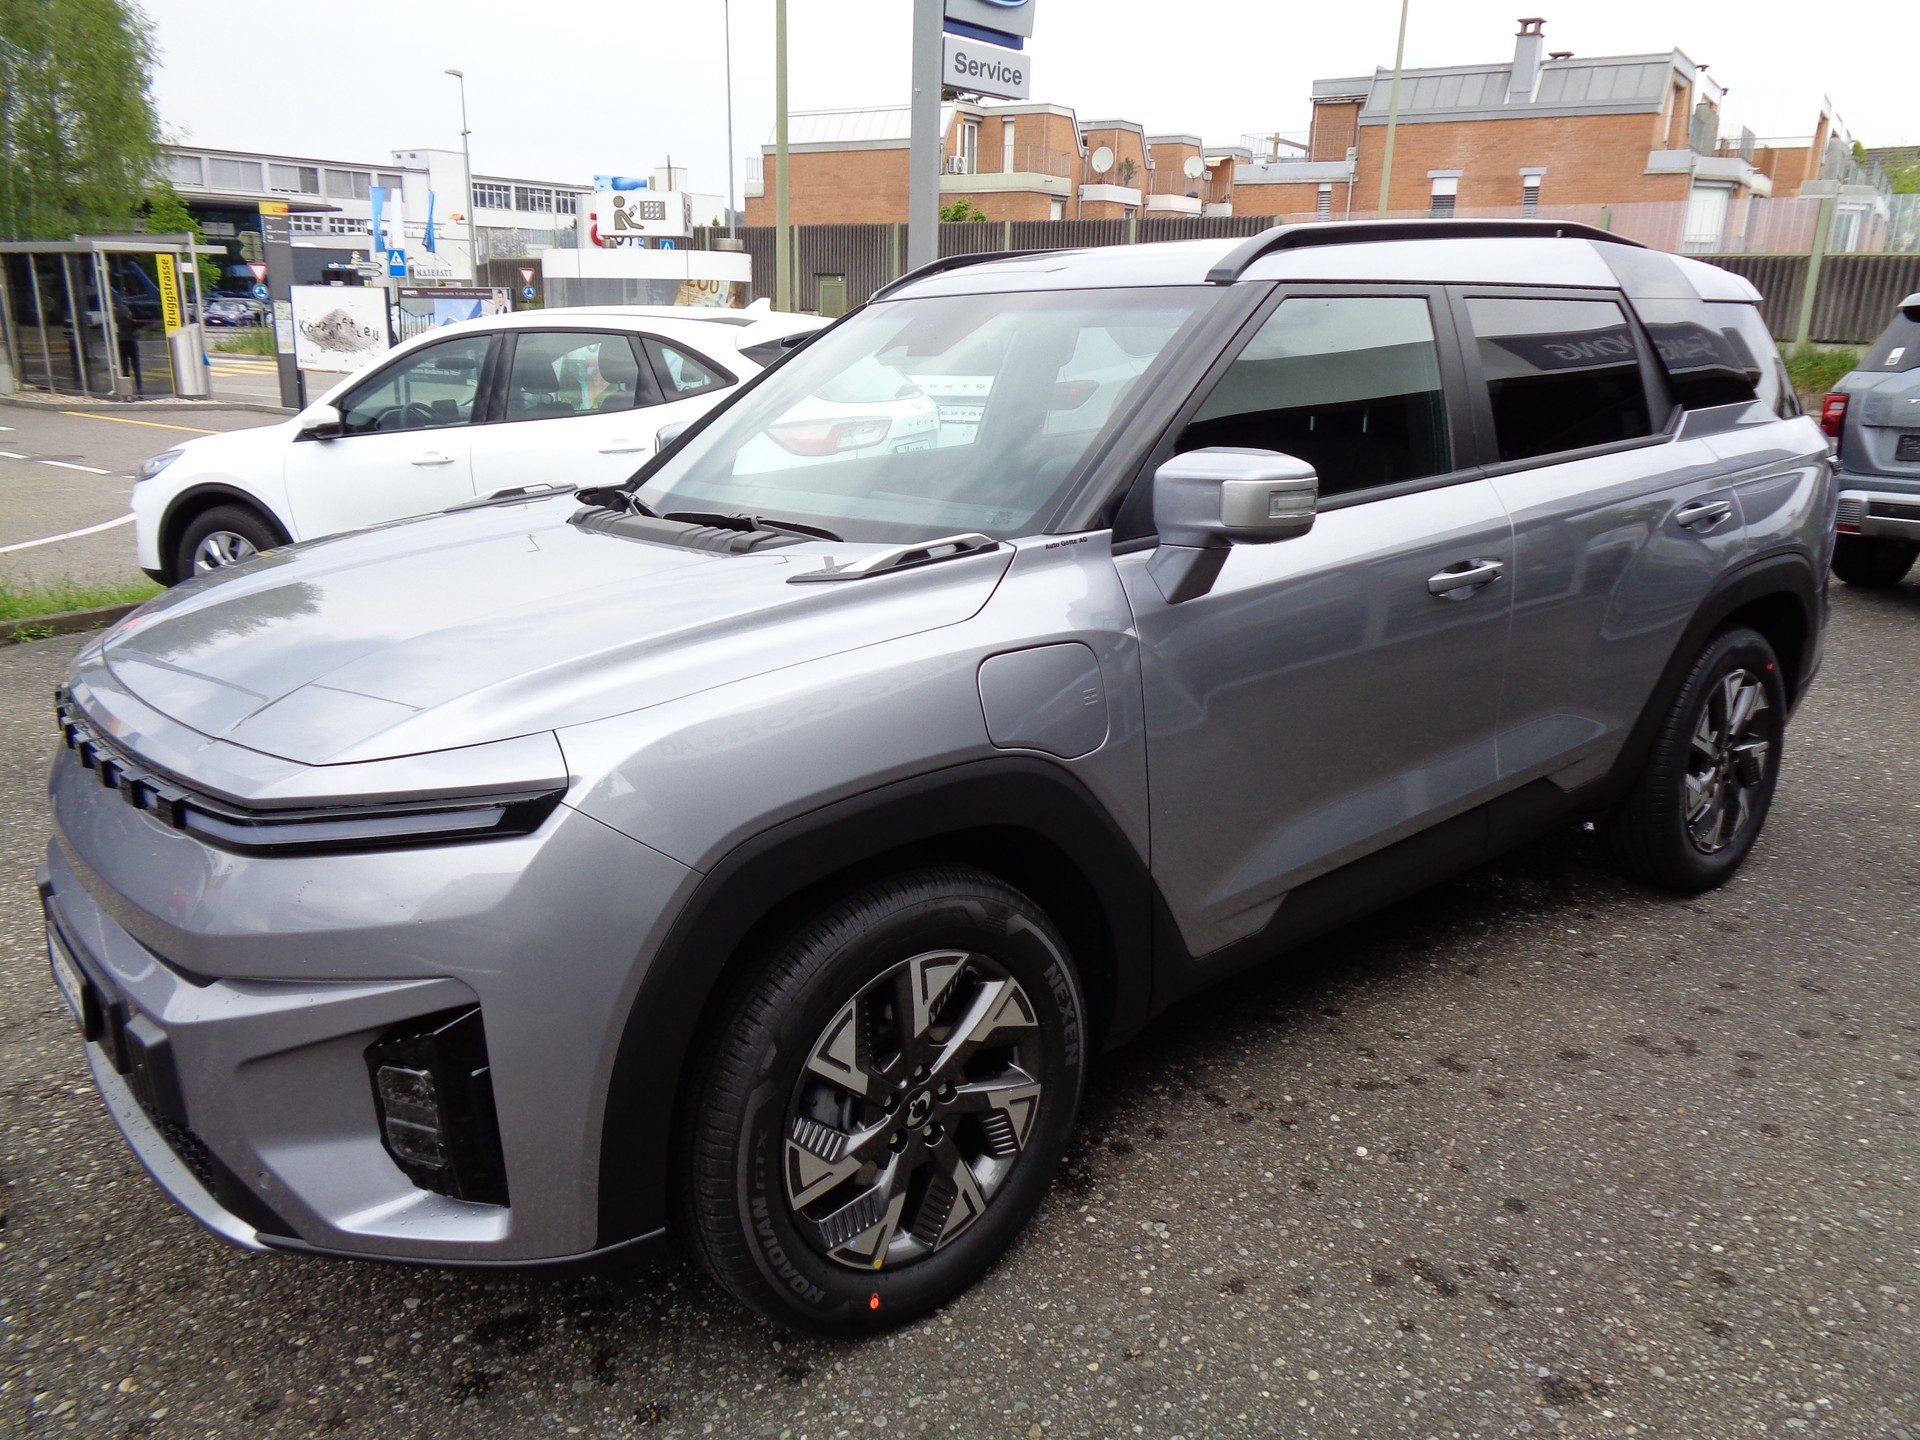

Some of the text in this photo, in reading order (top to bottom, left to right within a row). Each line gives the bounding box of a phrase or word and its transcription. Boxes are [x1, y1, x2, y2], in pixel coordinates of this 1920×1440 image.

[954, 52, 1022, 86] Service
[161, 258, 177, 327] Bruggstrasse
[416, 268, 453, 277] MASERATI
[1043, 962, 1079, 1067] NEXEN
[752, 1197, 826, 1303] ROADIAN
